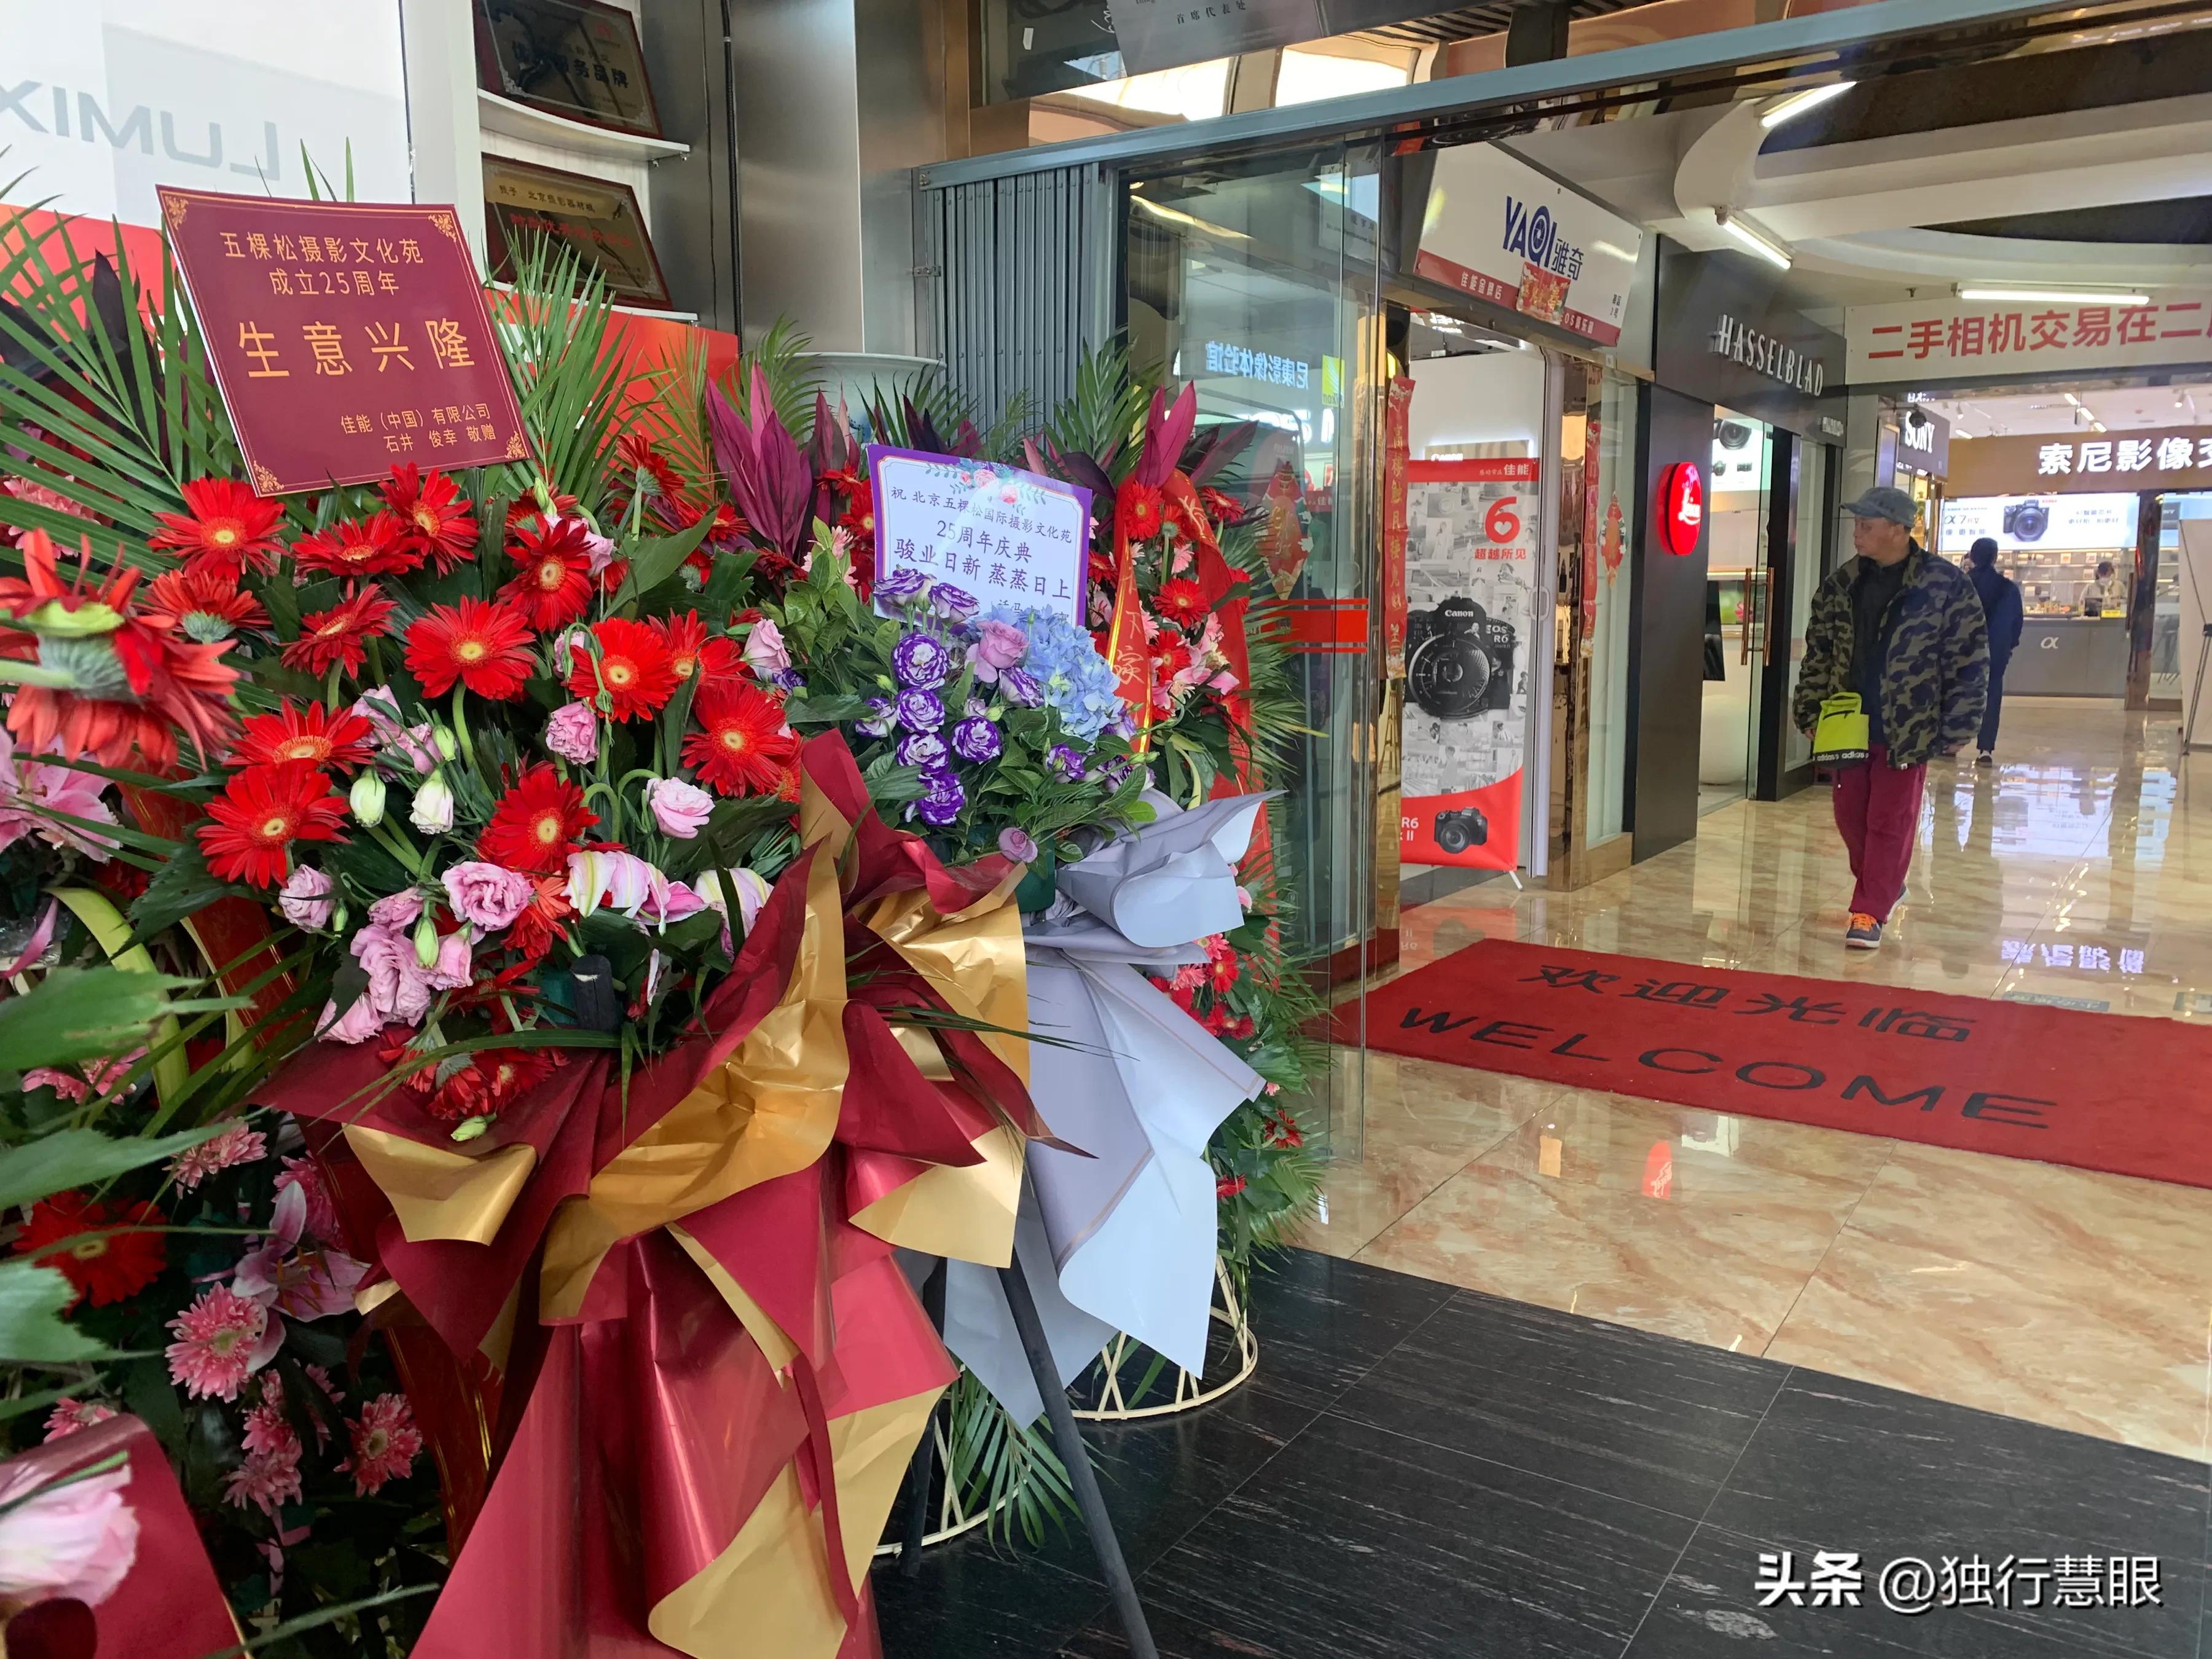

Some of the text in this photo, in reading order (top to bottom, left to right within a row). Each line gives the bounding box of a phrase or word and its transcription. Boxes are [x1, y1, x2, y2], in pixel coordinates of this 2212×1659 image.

[1177, 0, 1246, 24] 首席代表处
[219, 231, 423, 264] 五棵松摄影文化苑
[1503, 195, 1584, 280] YAQI 雅奇
[269, 268, 399, 296] 成立25周年
[238, 316, 475, 377] 生意兴隆
[1719, 314, 1824, 397] HASSELBLAD
[383, 423, 496, 453] 石井 俊幸 敬赠
[1504, 463, 1530, 476] 佳能
[891, 487, 1072, 543] 祝 北京五棵松国际摄影文化苑
[1484, 496, 1521, 544] 6
[936, 520, 1032, 563] 25周年庆典
[1474, 548, 1527, 560] 超越所见
[893, 538, 1071, 600] 骏业日新 蒸蒸日上
[1445, 609, 1474, 618] Canon
[1494, 635, 1508, 643] R6
[1401, 817, 1419, 830] R6
[1518, 965, 1977, 1043] 欢迎光临
[1399, 1006, 2057, 1129] WELCOME
